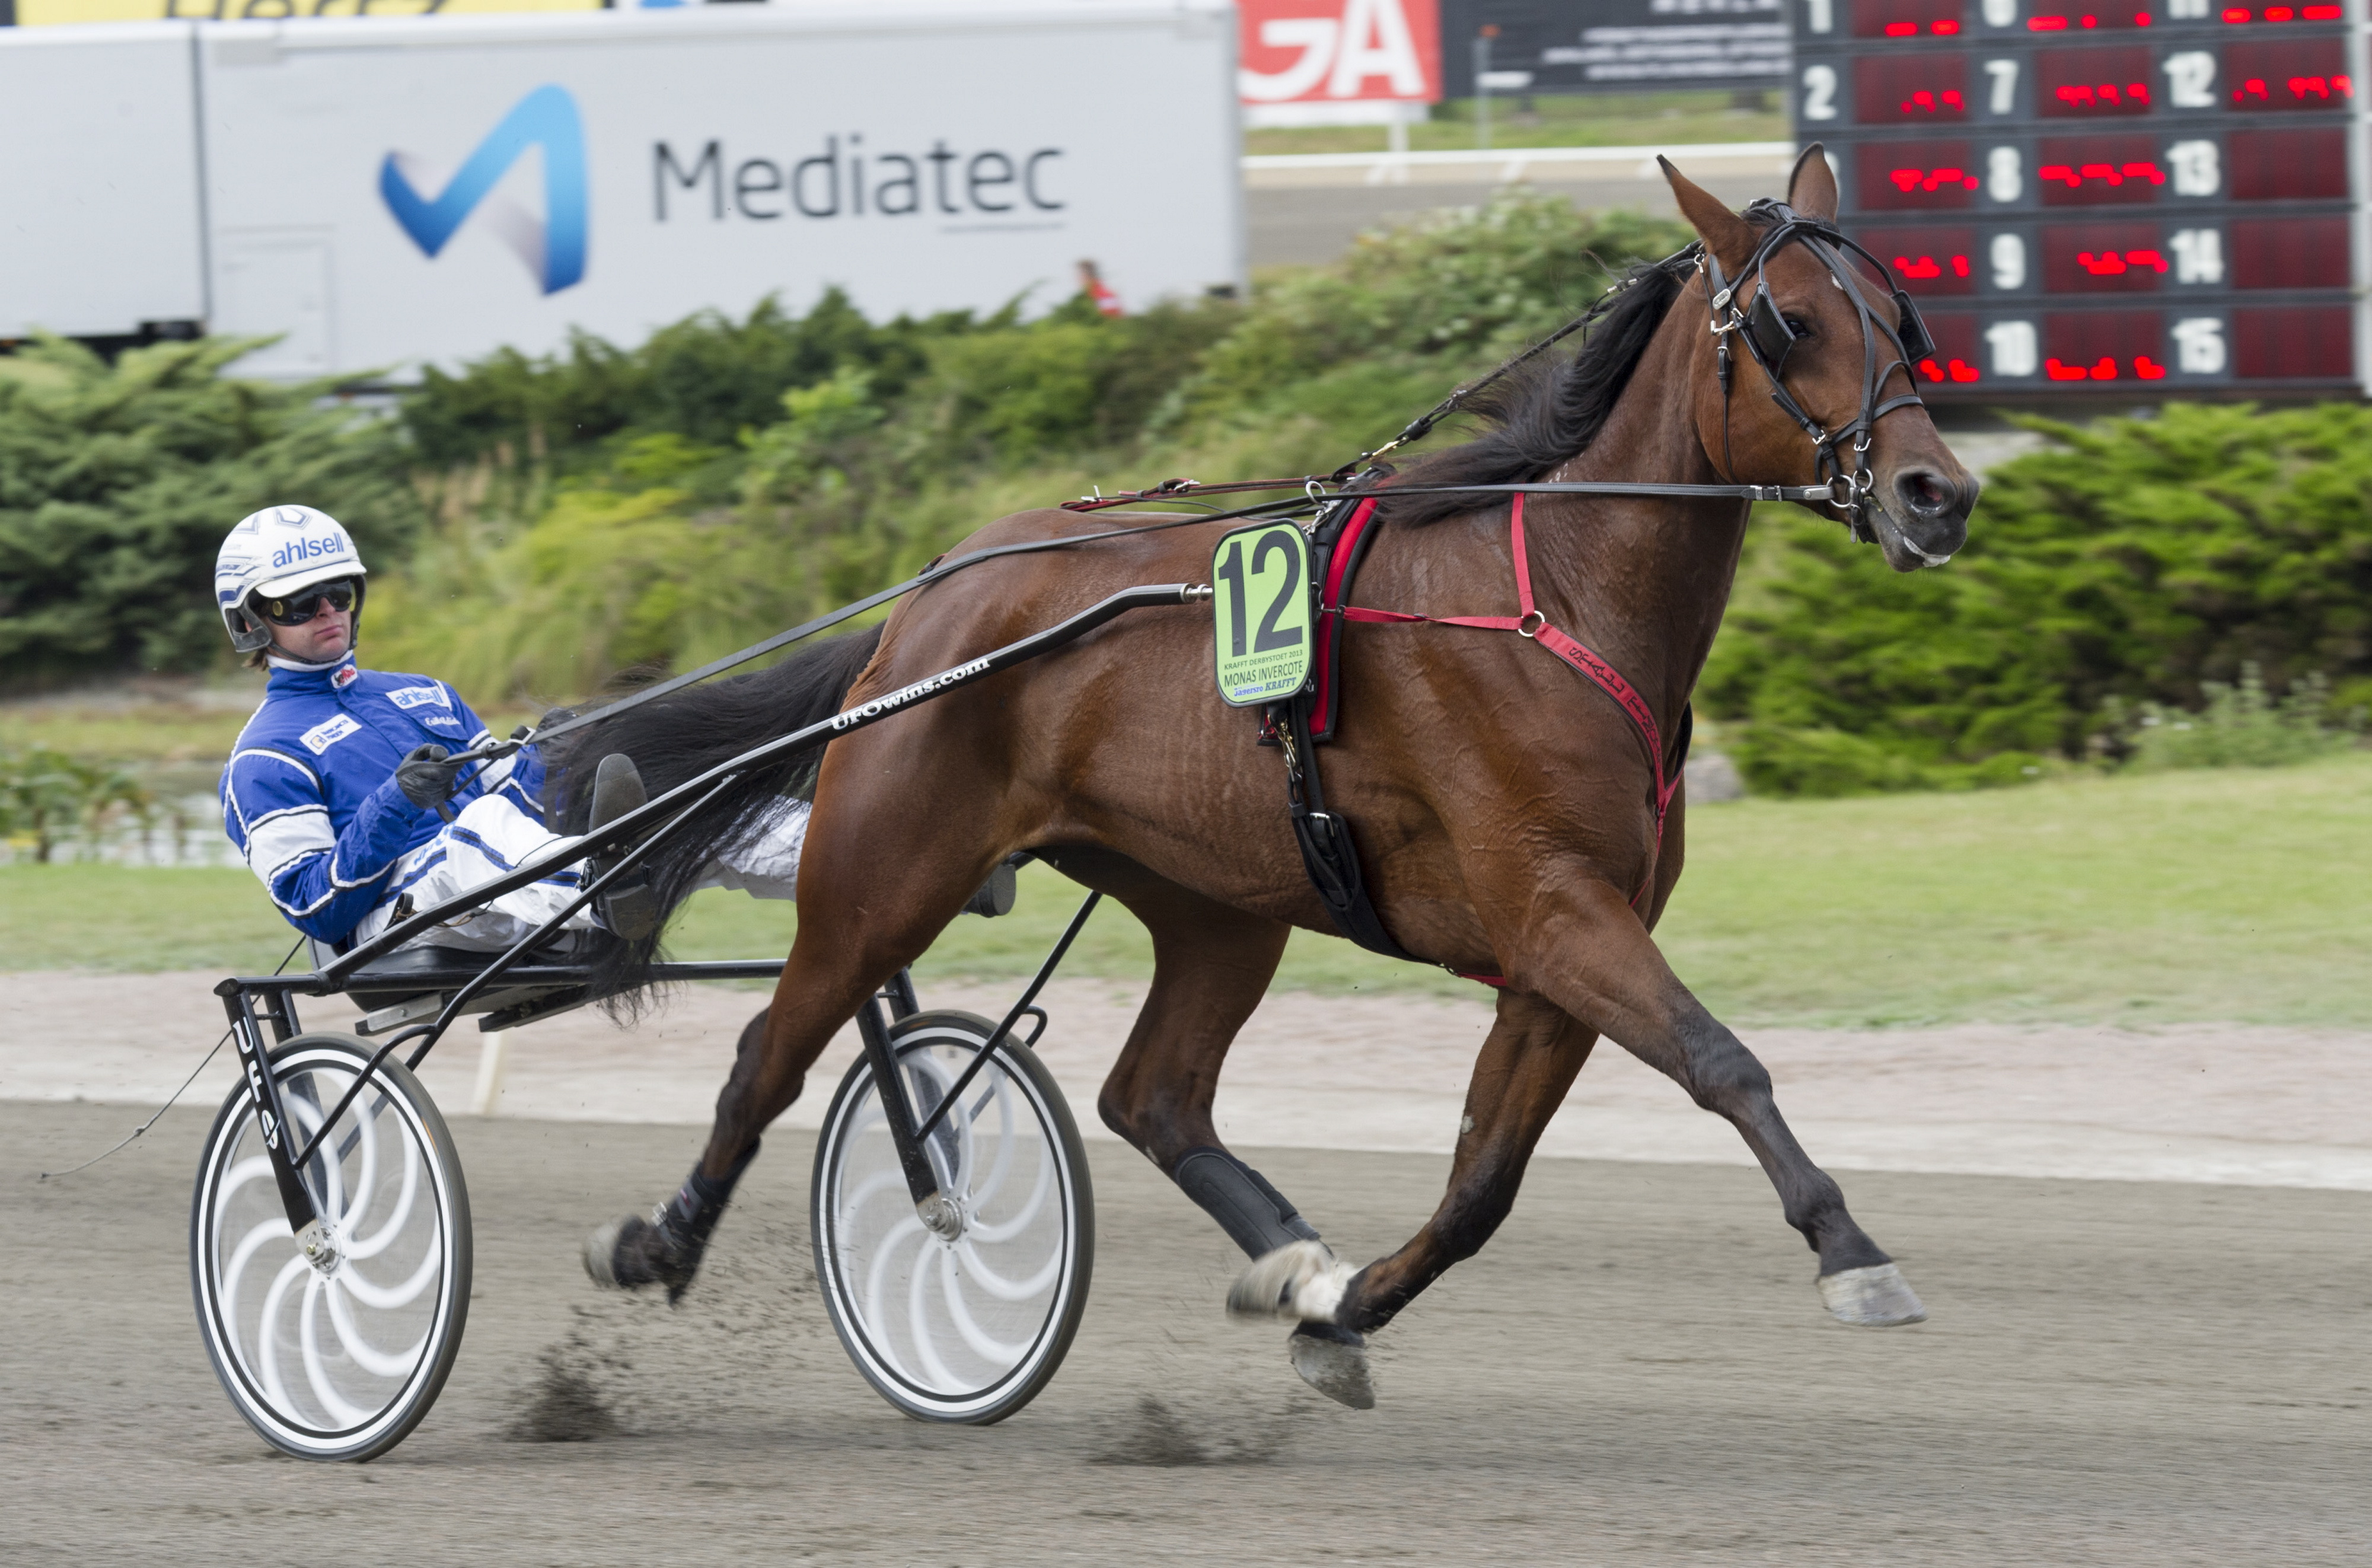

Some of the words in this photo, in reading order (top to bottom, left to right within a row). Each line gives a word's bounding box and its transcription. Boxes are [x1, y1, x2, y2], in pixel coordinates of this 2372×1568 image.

[1803, 65, 1837, 120] 2
[1984, 59, 2017, 114] 7
[2163, 51, 2216, 108] 12
[653, 133, 1067, 222] Mediatec
[1988, 146, 2022, 202] 8
[2166, 139, 2220, 196] 13
[1991, 234, 2026, 289] 9
[2169, 229, 2224, 283] 14
[1985, 320, 2037, 377] 10
[272, 533, 345, 568] ahlsell
[1219, 530, 1303, 657] 12
[1225, 661, 1247, 670] KRAFFT
[1289, 649, 1303, 658] 2013
[1225, 670, 1257, 687] MONAS
[1259, 661, 1303, 680] INVERCOTE
[1265, 677, 1296, 691] KRAFFT
[831, 658, 990, 730] UFOwins.com
